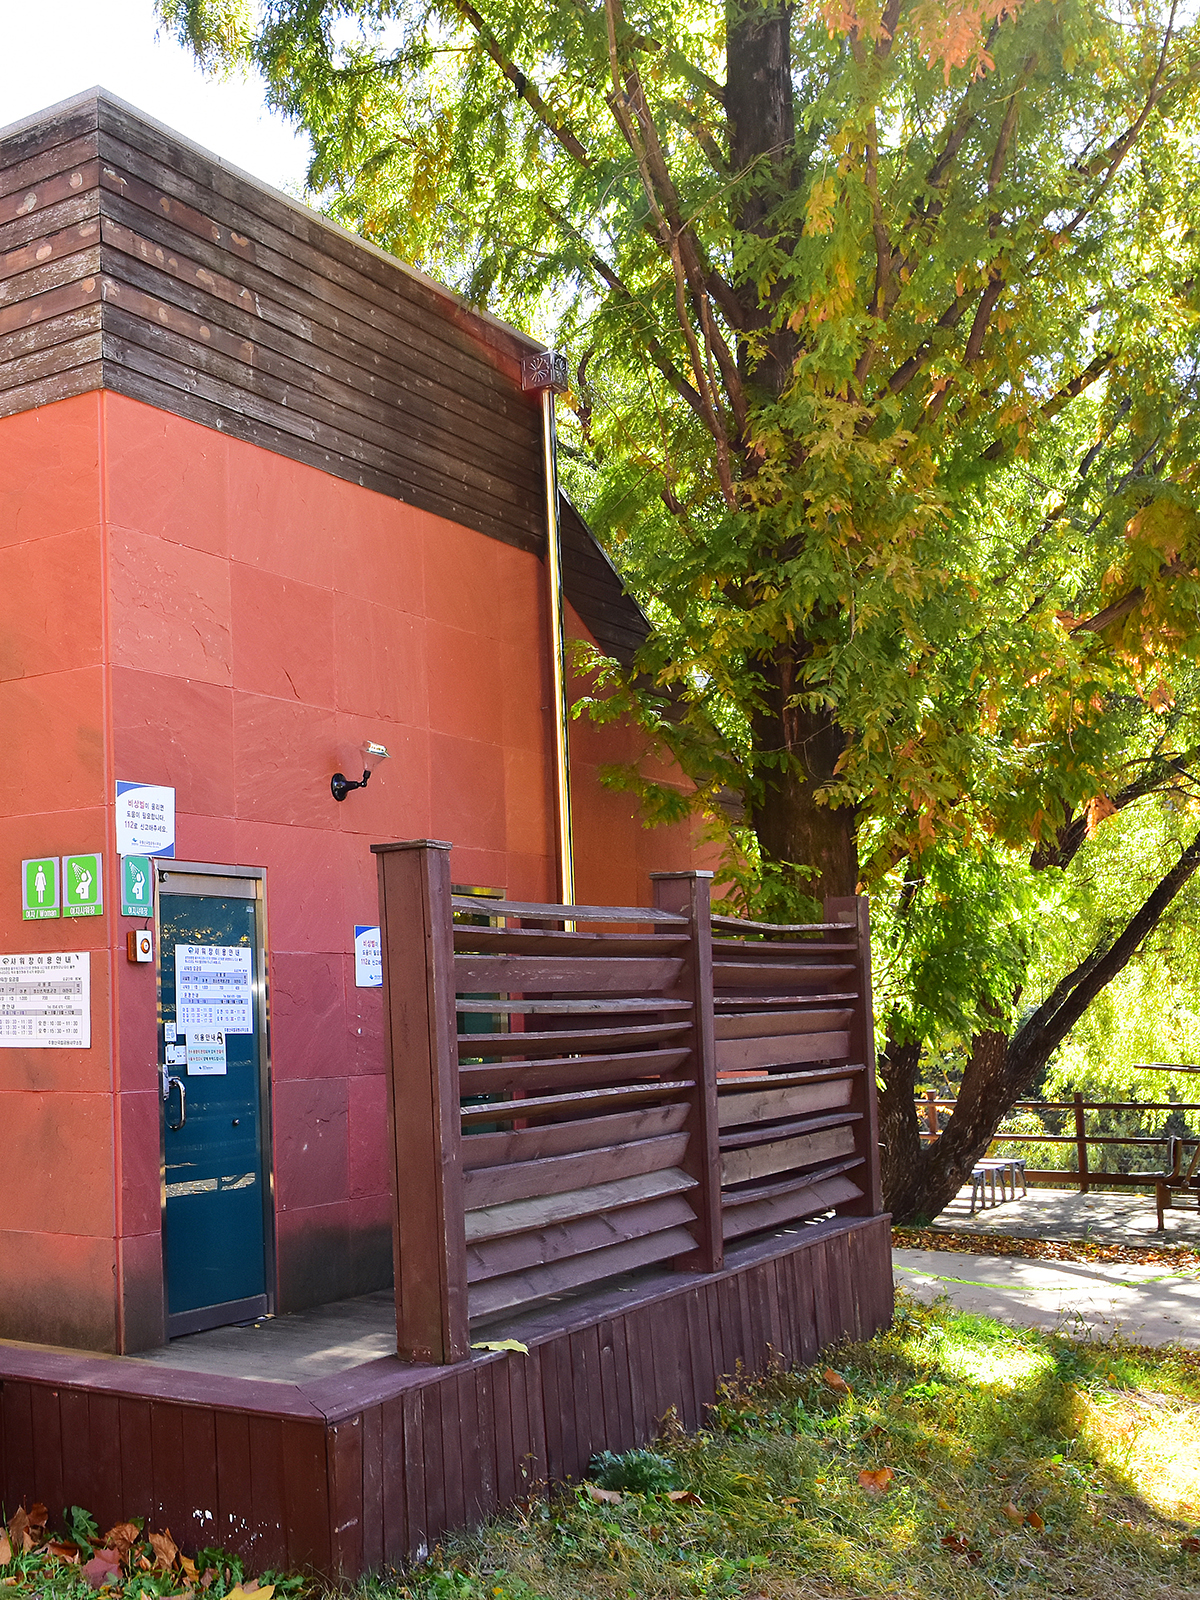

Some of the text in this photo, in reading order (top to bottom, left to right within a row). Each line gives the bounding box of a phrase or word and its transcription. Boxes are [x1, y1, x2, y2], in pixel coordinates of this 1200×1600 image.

[128, 800, 149, 809] 비상벨이
[127, 810, 165, 821] 도움이 필요합니다.
[124, 820, 138, 830] 112로
[26, 910, 35, 918] 여자
[70, 905, 95, 915] 여자샤워장
[194, 1033, 216, 1041] 이용안내
